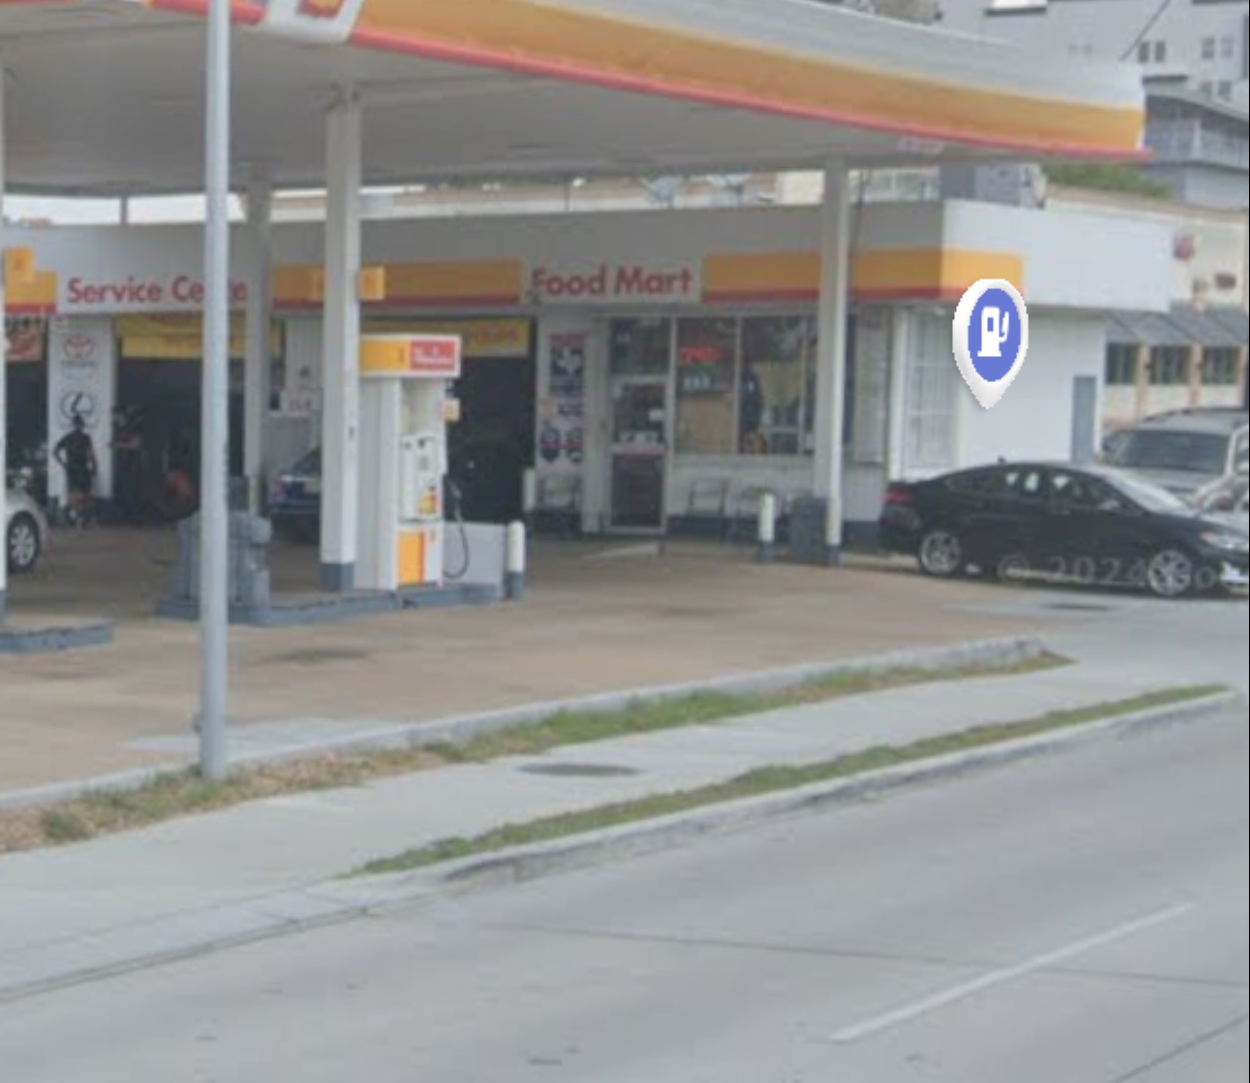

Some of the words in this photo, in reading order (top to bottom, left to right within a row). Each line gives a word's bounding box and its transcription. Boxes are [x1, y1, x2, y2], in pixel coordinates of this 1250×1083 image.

[67, 276, 161, 303] Service
[171, 275, 248, 302] Cee
[532, 264, 607, 296] Food
[613, 266, 692, 296] Mart
